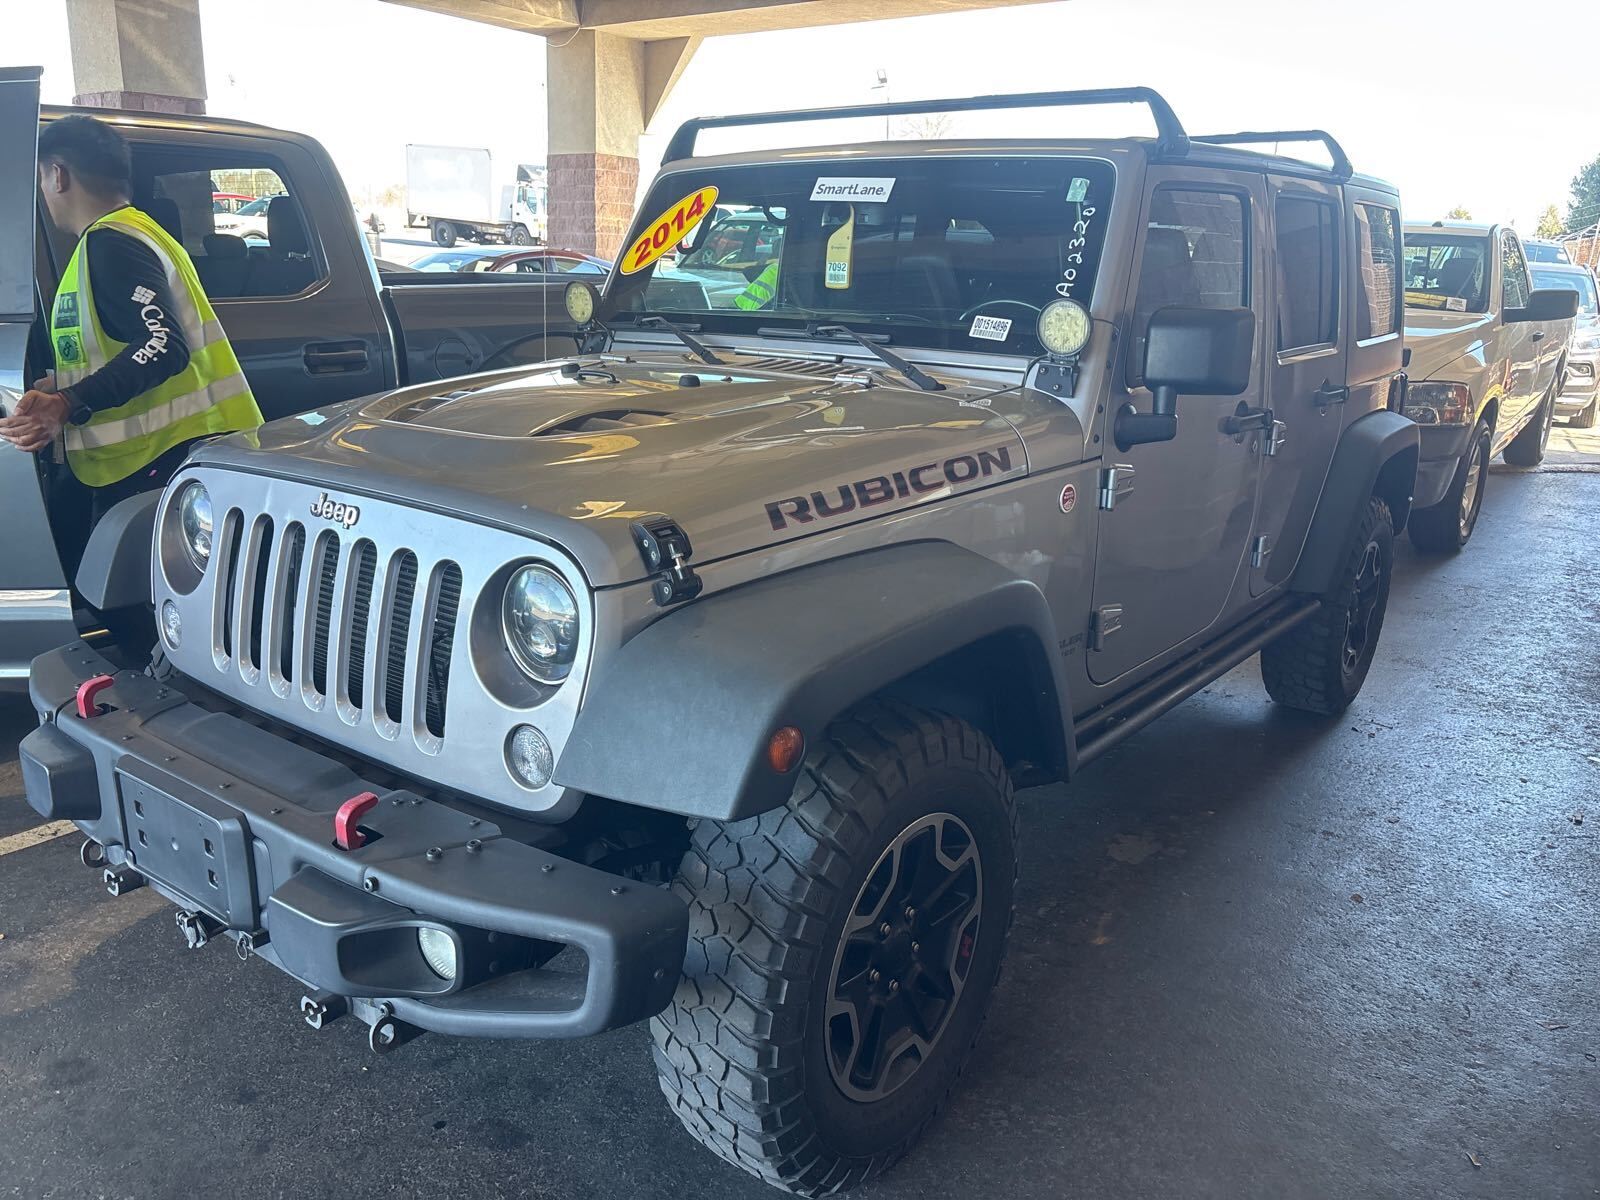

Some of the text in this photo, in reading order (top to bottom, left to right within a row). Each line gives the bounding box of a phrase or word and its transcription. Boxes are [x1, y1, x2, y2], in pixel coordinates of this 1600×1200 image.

[815, 183, 884, 196] SmartLane
[634, 192, 705, 268] 2014
[828, 262, 847, 272] 7092
[131, 304, 170, 365] Colmbia
[310, 492, 360, 530] Jeep
[764, 446, 1012, 531] RUBICON
